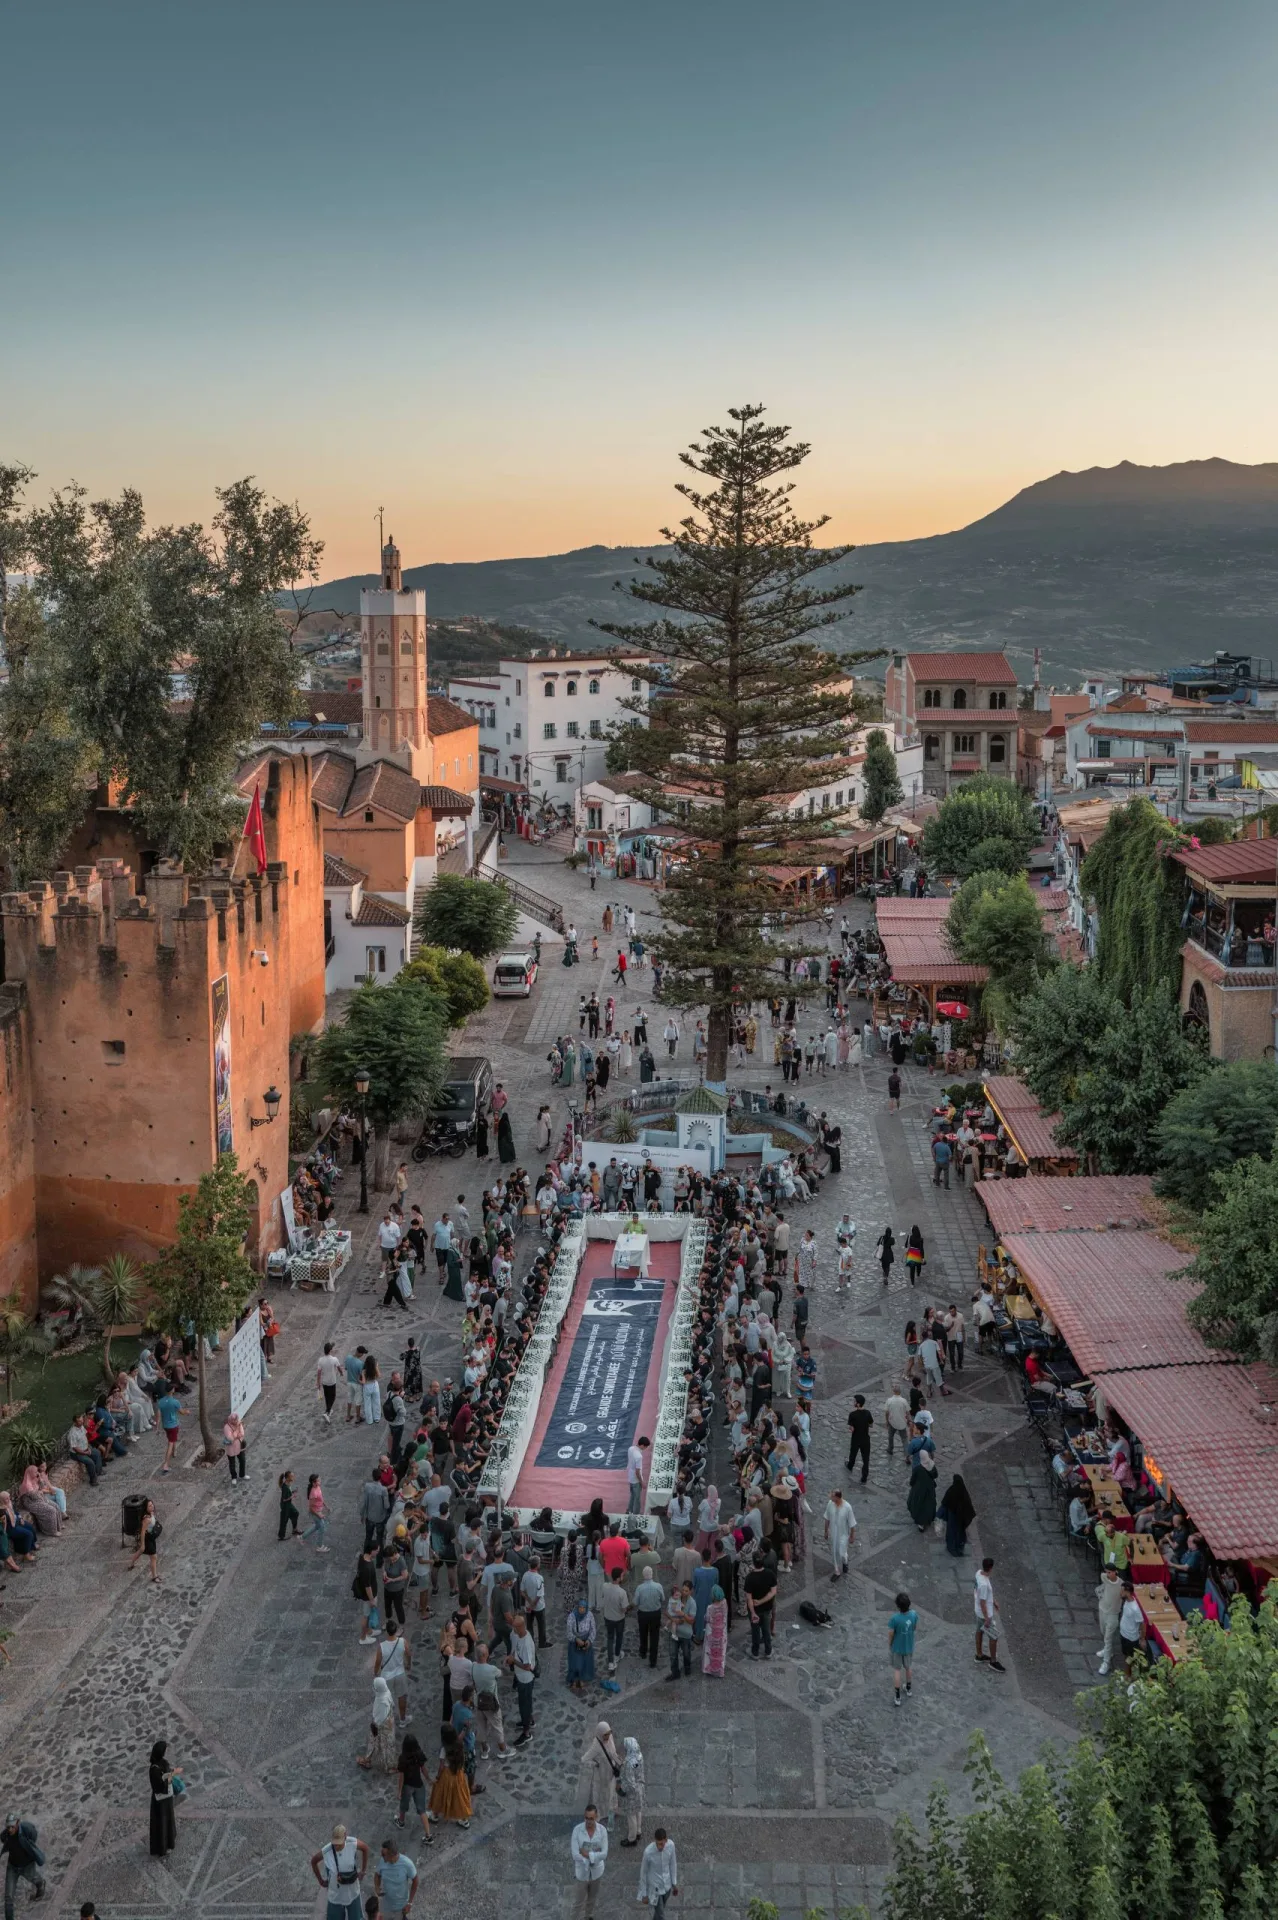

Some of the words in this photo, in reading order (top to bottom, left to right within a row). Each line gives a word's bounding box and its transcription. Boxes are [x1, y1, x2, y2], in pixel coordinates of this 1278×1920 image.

[603, 1362, 620, 1394] SIMULTANÉE
[596, 1394, 612, 1418] GRANDE
[606, 1418, 618, 1439] AGL
